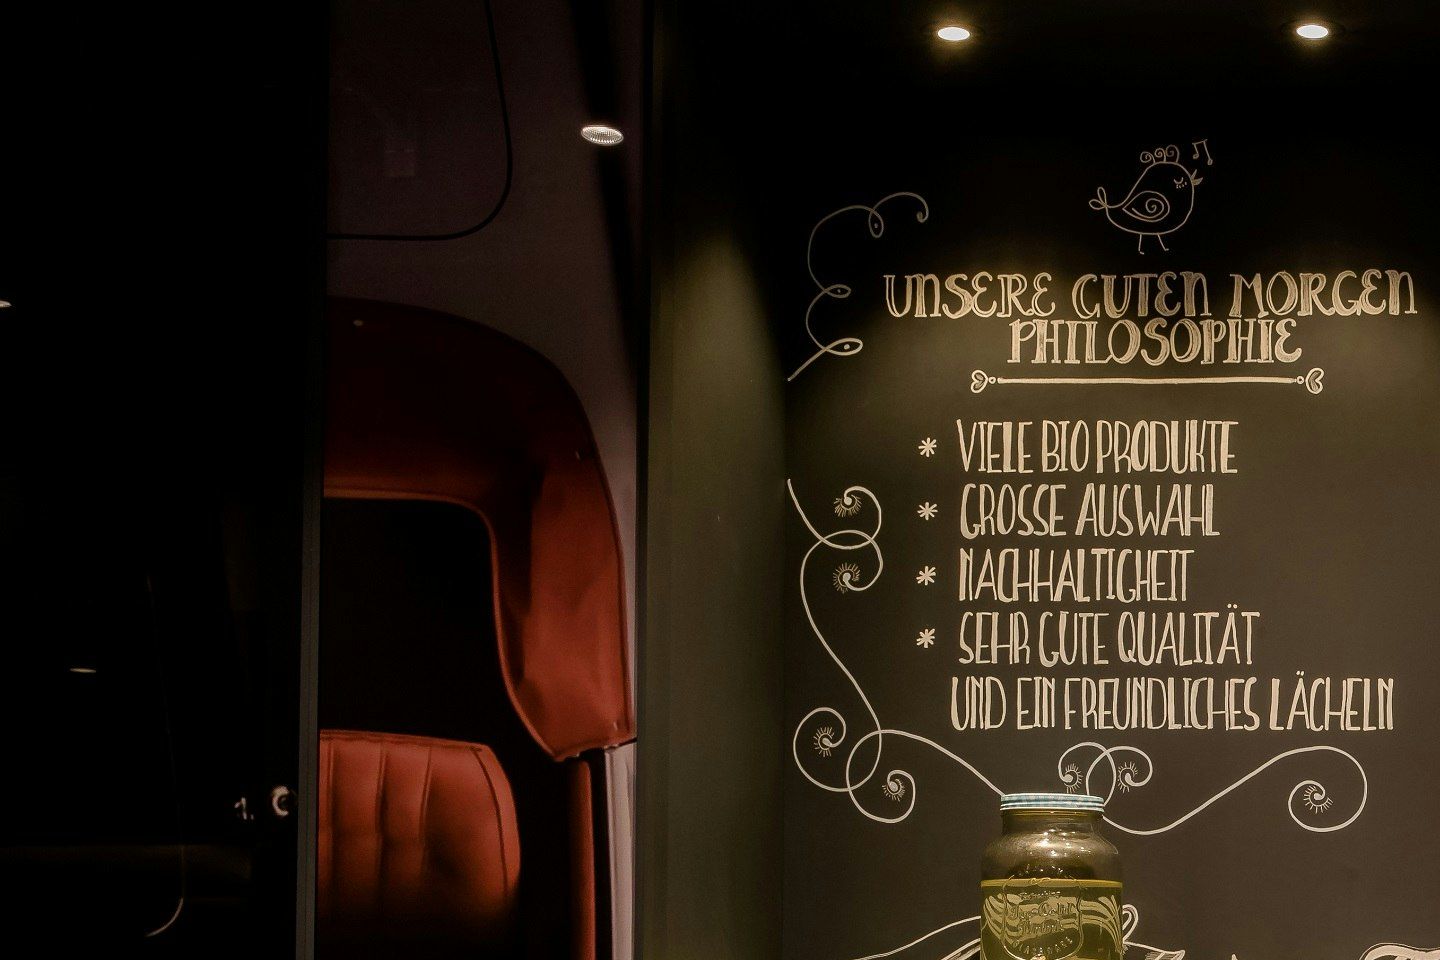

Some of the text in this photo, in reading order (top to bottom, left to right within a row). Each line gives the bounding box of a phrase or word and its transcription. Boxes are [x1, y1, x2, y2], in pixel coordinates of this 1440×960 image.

[883, 268, 1419, 319] UNSERE GUTEN MORGEN
[1006, 317, 1303, 365] PHILOSOPHIE
[956, 418, 1239, 474] VIELE BIO PRODUKTE
[959, 483, 1221, 537] GROSSE AUSWAHL
[958, 603, 1261, 667] SEHR GUTE QUALITÄT
[950, 670, 1395, 732] UND EIN FREUNDLICHES LÄCHELN
